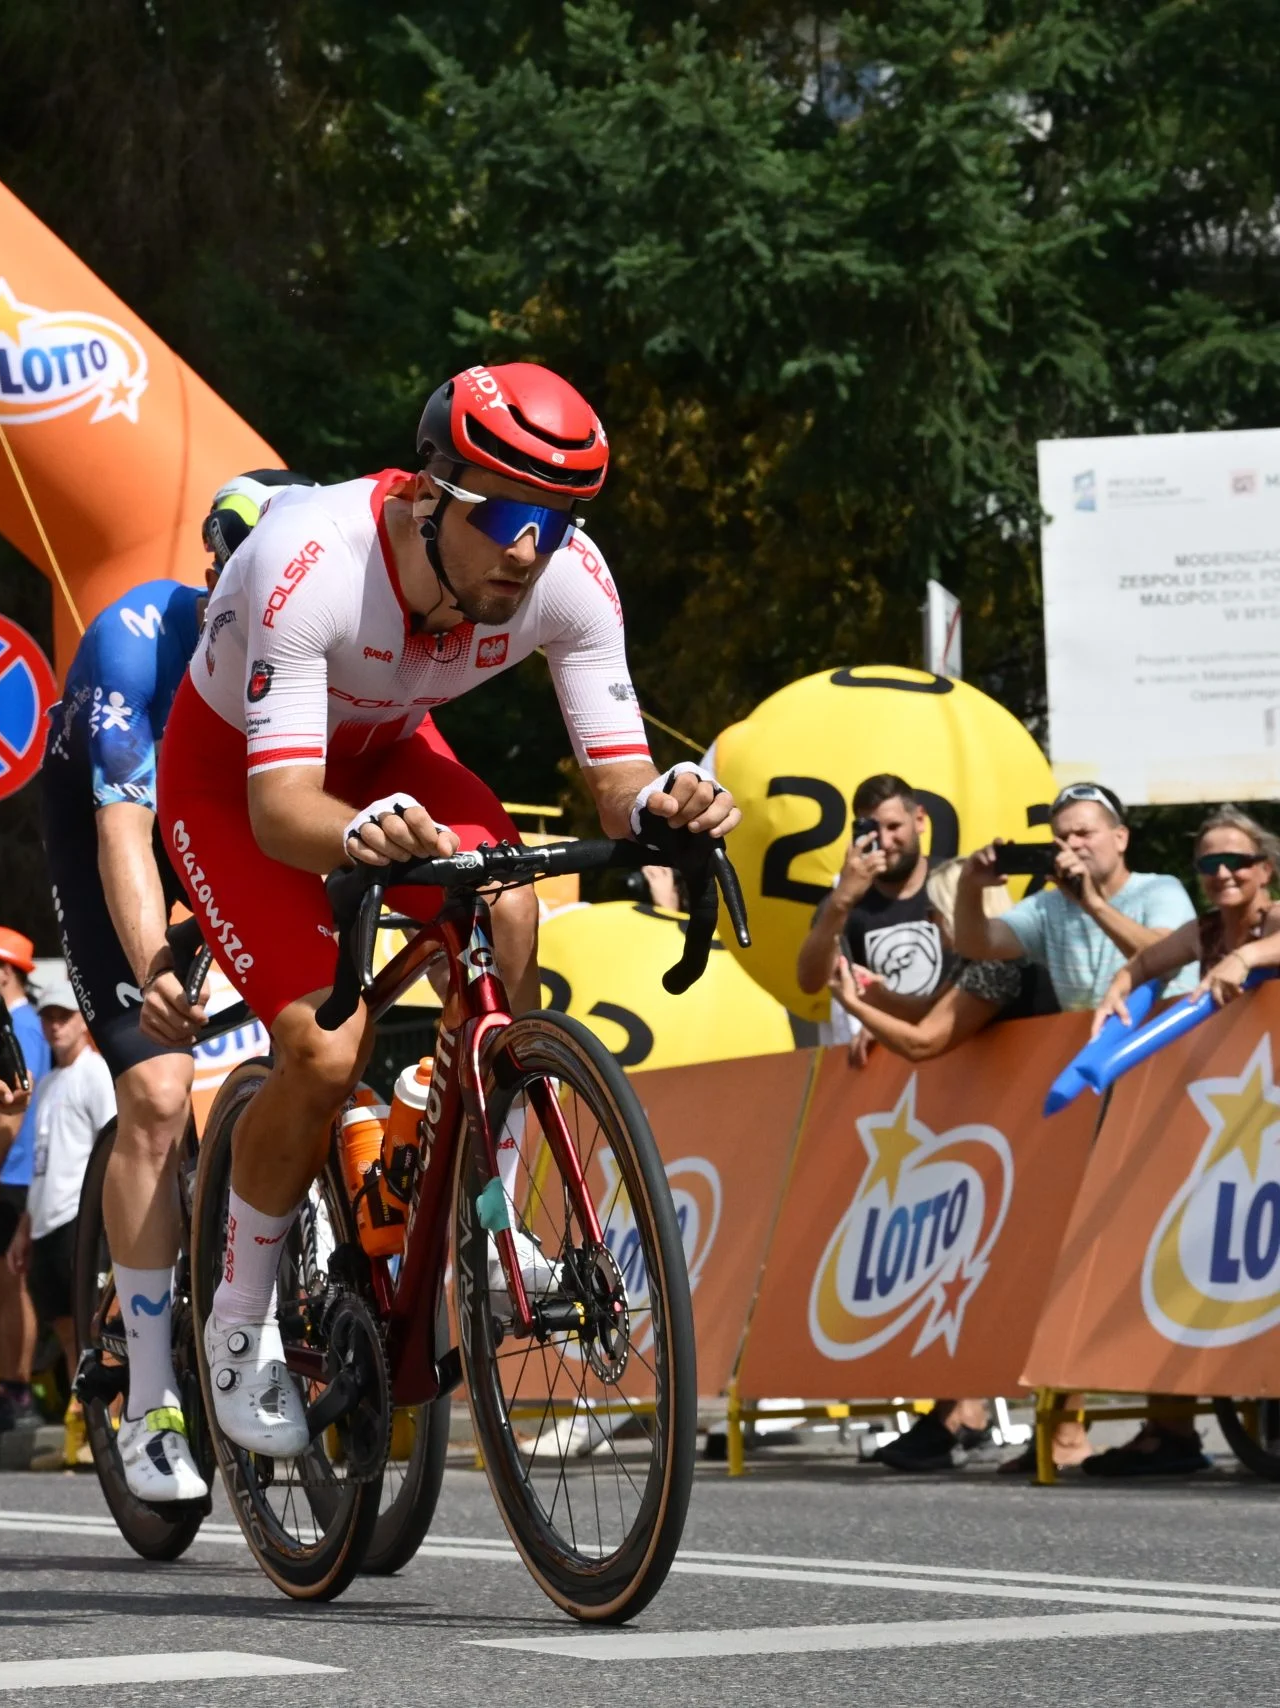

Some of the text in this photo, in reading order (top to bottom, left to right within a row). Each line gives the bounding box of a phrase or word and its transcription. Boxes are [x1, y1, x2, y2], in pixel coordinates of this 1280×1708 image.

[262, 540, 325, 629] POLSKA
[172, 819, 255, 985] Mazowsze.
[194, 1021, 261, 1060] OTT
[497, 1138, 516, 1150] est
[853, 1178, 970, 1302] LOTTO
